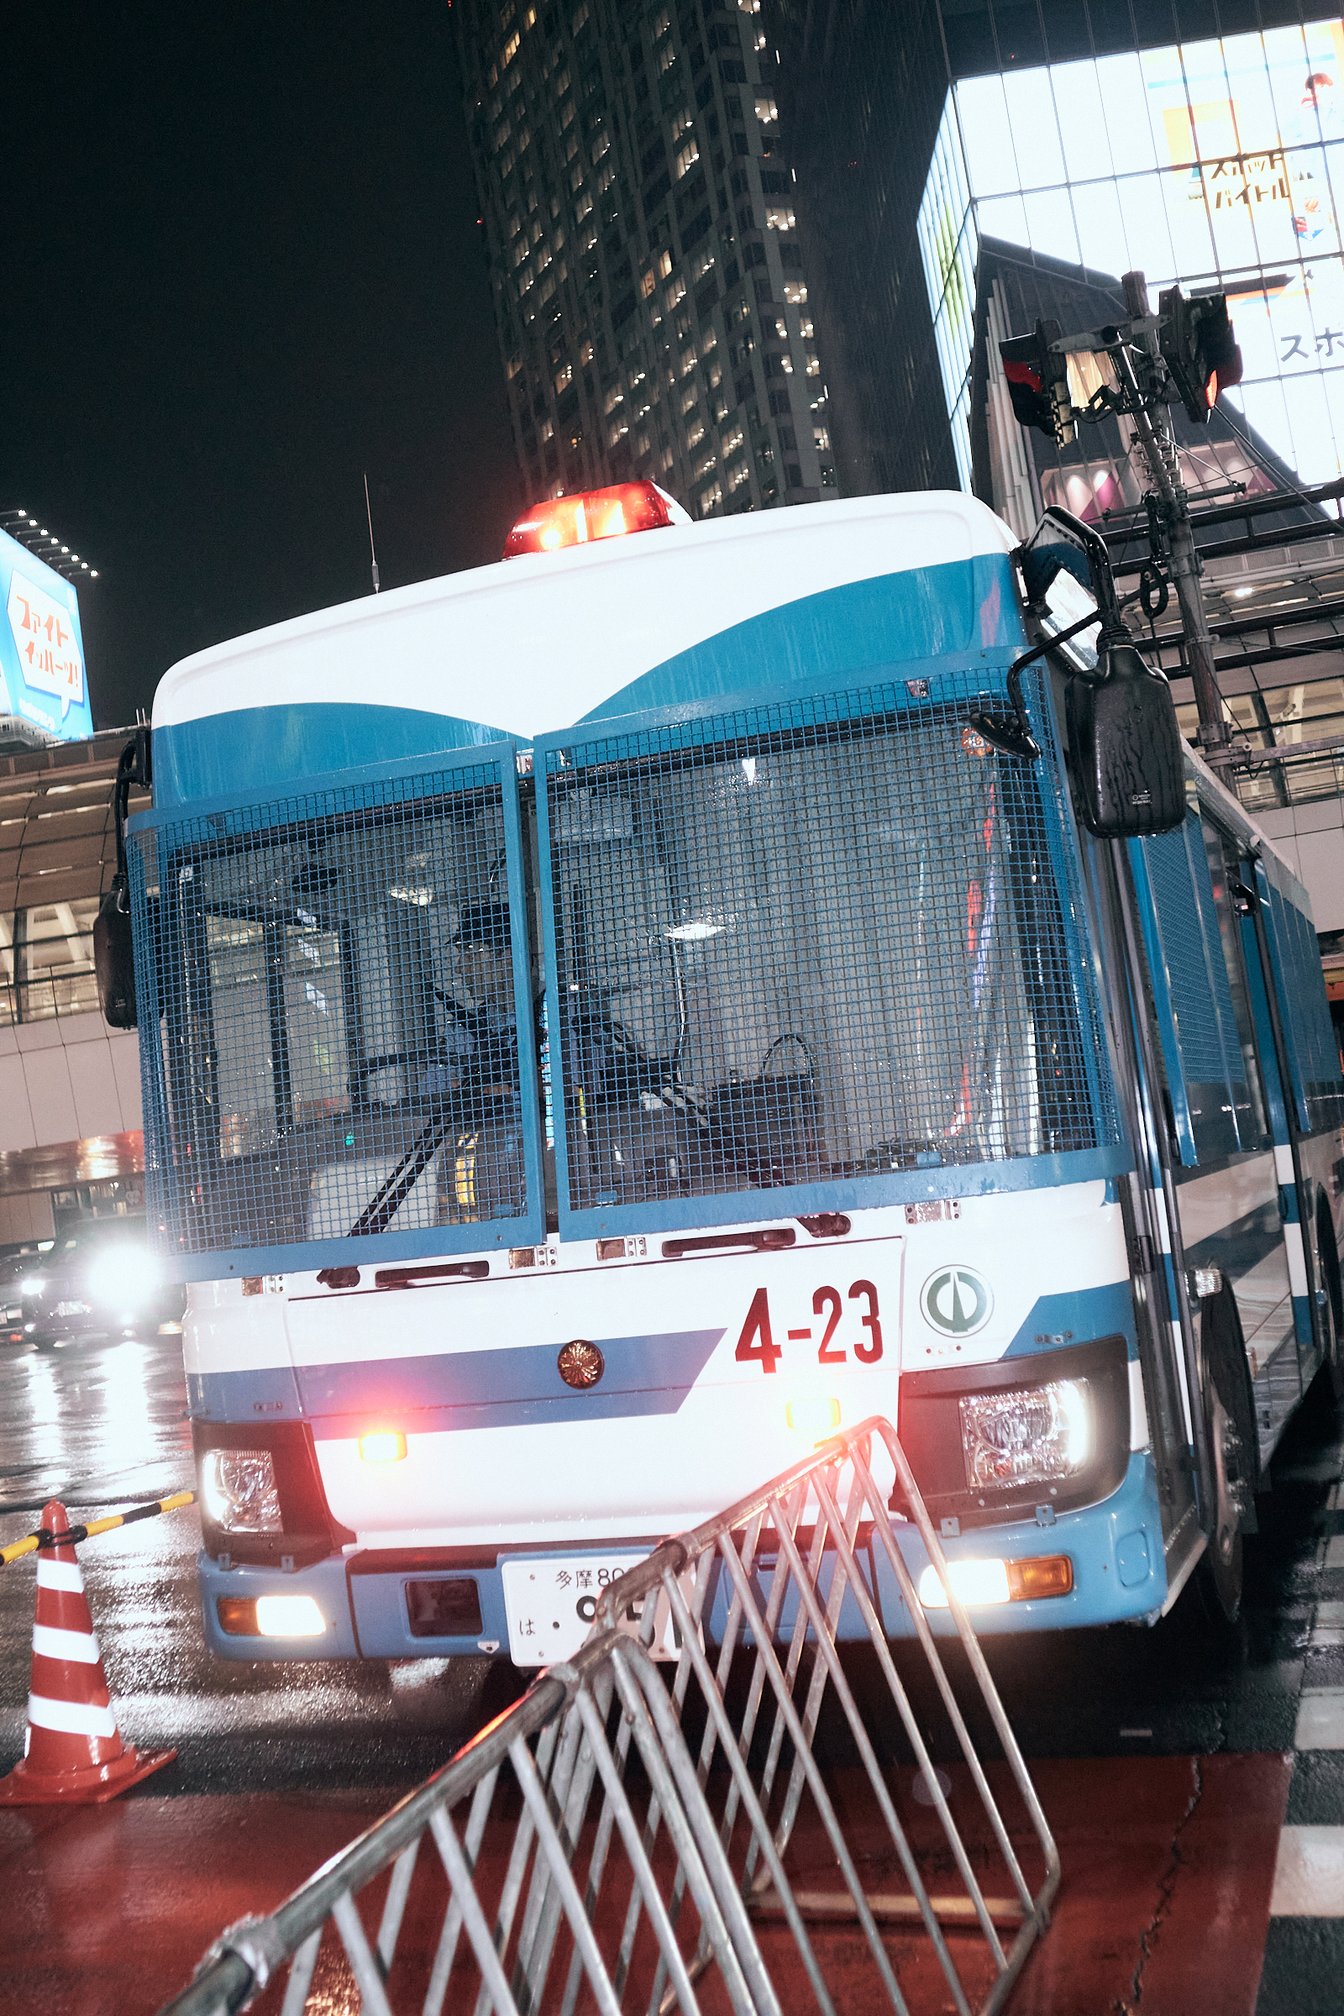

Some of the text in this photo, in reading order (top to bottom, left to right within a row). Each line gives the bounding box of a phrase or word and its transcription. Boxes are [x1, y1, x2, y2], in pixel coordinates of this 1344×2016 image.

[1215, 177, 1290, 208] バイトル
[16, 594, 69, 648] ファイト
[734, 1279, 884, 1374] 4-23
[555, 1567, 635, 1590] 多摩 80
[518, 1618, 537, 1637] は
